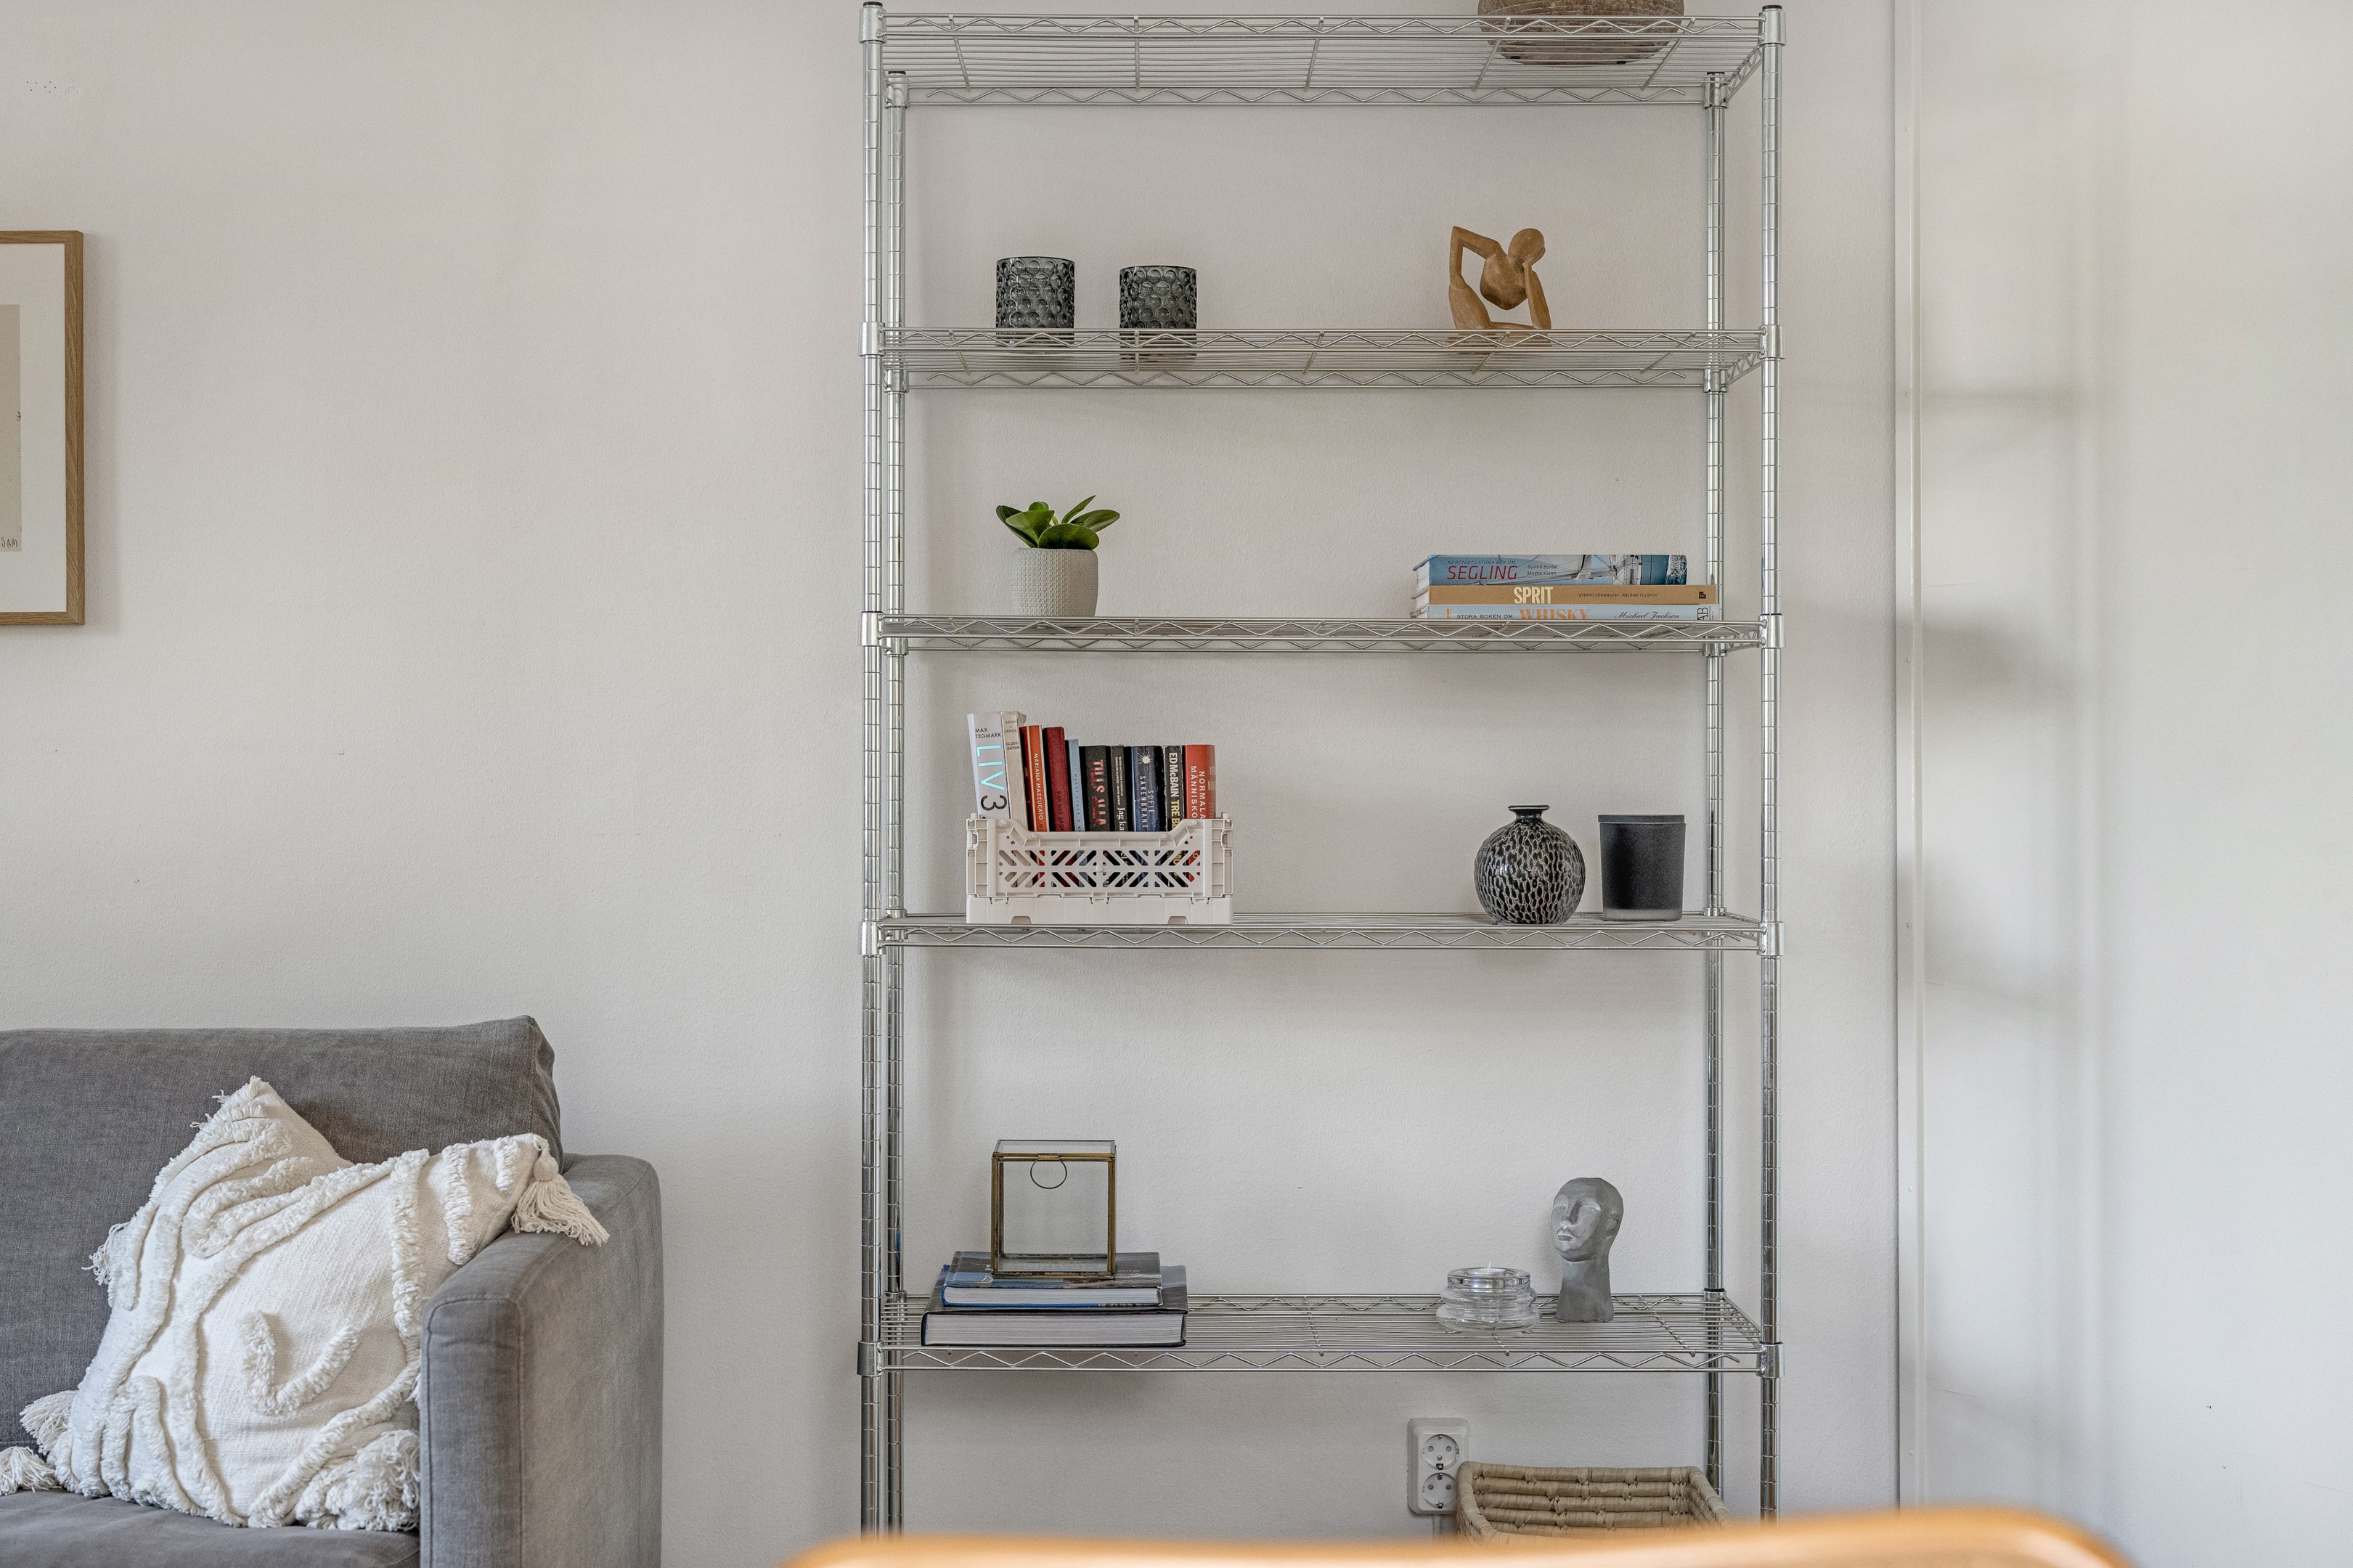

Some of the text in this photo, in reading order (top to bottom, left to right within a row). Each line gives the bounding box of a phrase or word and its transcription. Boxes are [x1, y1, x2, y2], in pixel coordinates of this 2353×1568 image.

[1447, 565, 1518, 580] SEGLING
[1513, 587, 1554, 604] SPRIT
[1519, 608, 1591, 620] WHISKY
[1649, 611, 1679, 621] Jackson
[976, 745, 1006, 791] LIV
[1190, 766, 1199, 818] MÄNNISKO
[1116, 807, 1125, 820] Jag
[1170, 800, 1180, 817] TRE
